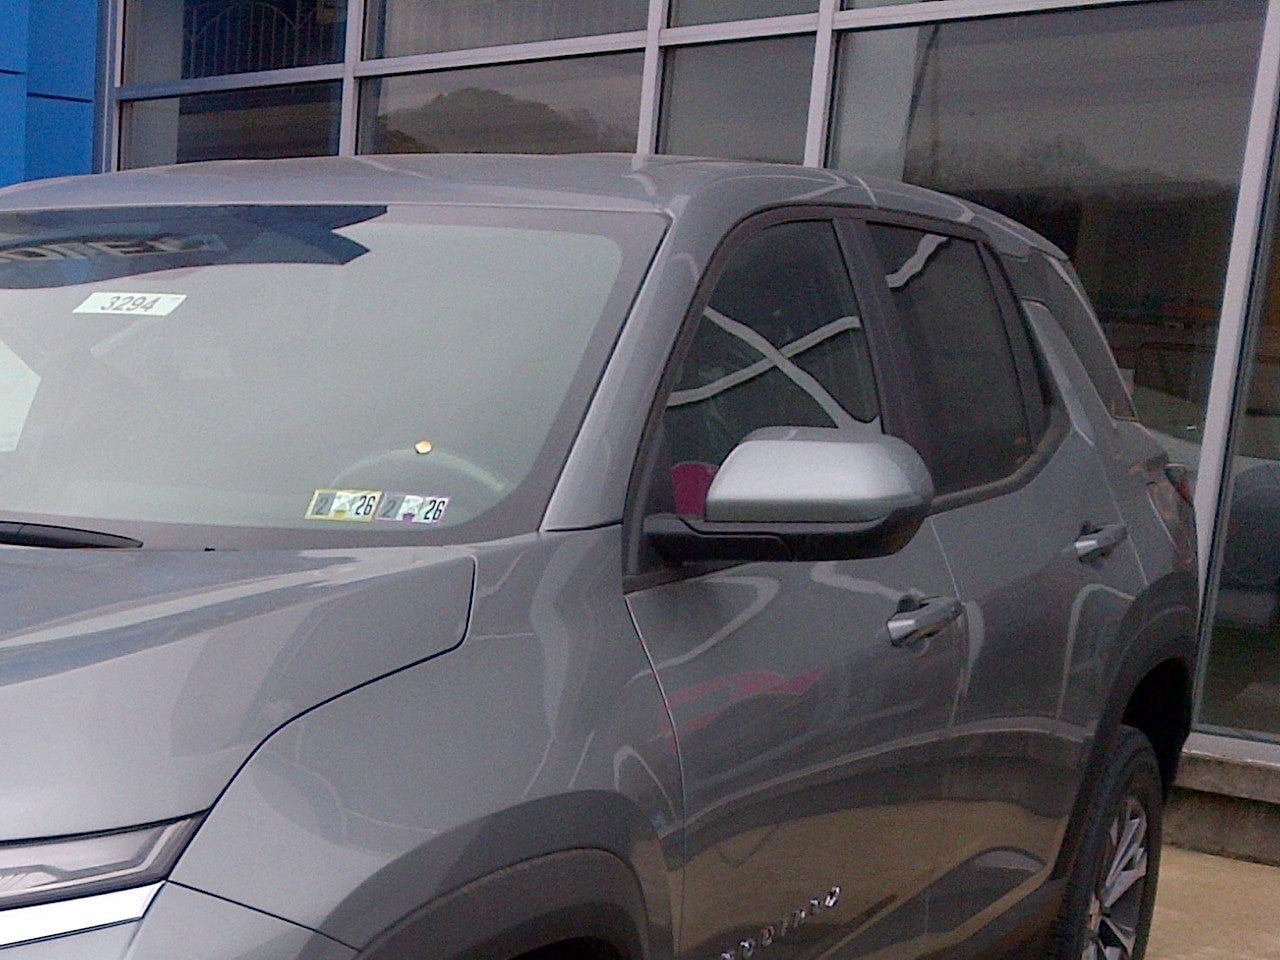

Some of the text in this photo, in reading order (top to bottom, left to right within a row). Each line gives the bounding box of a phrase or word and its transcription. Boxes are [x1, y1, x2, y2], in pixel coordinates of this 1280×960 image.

[100, 295, 162, 312] 3294
[355, 495, 376, 516] 26
[423, 500, 446, 521] 26
